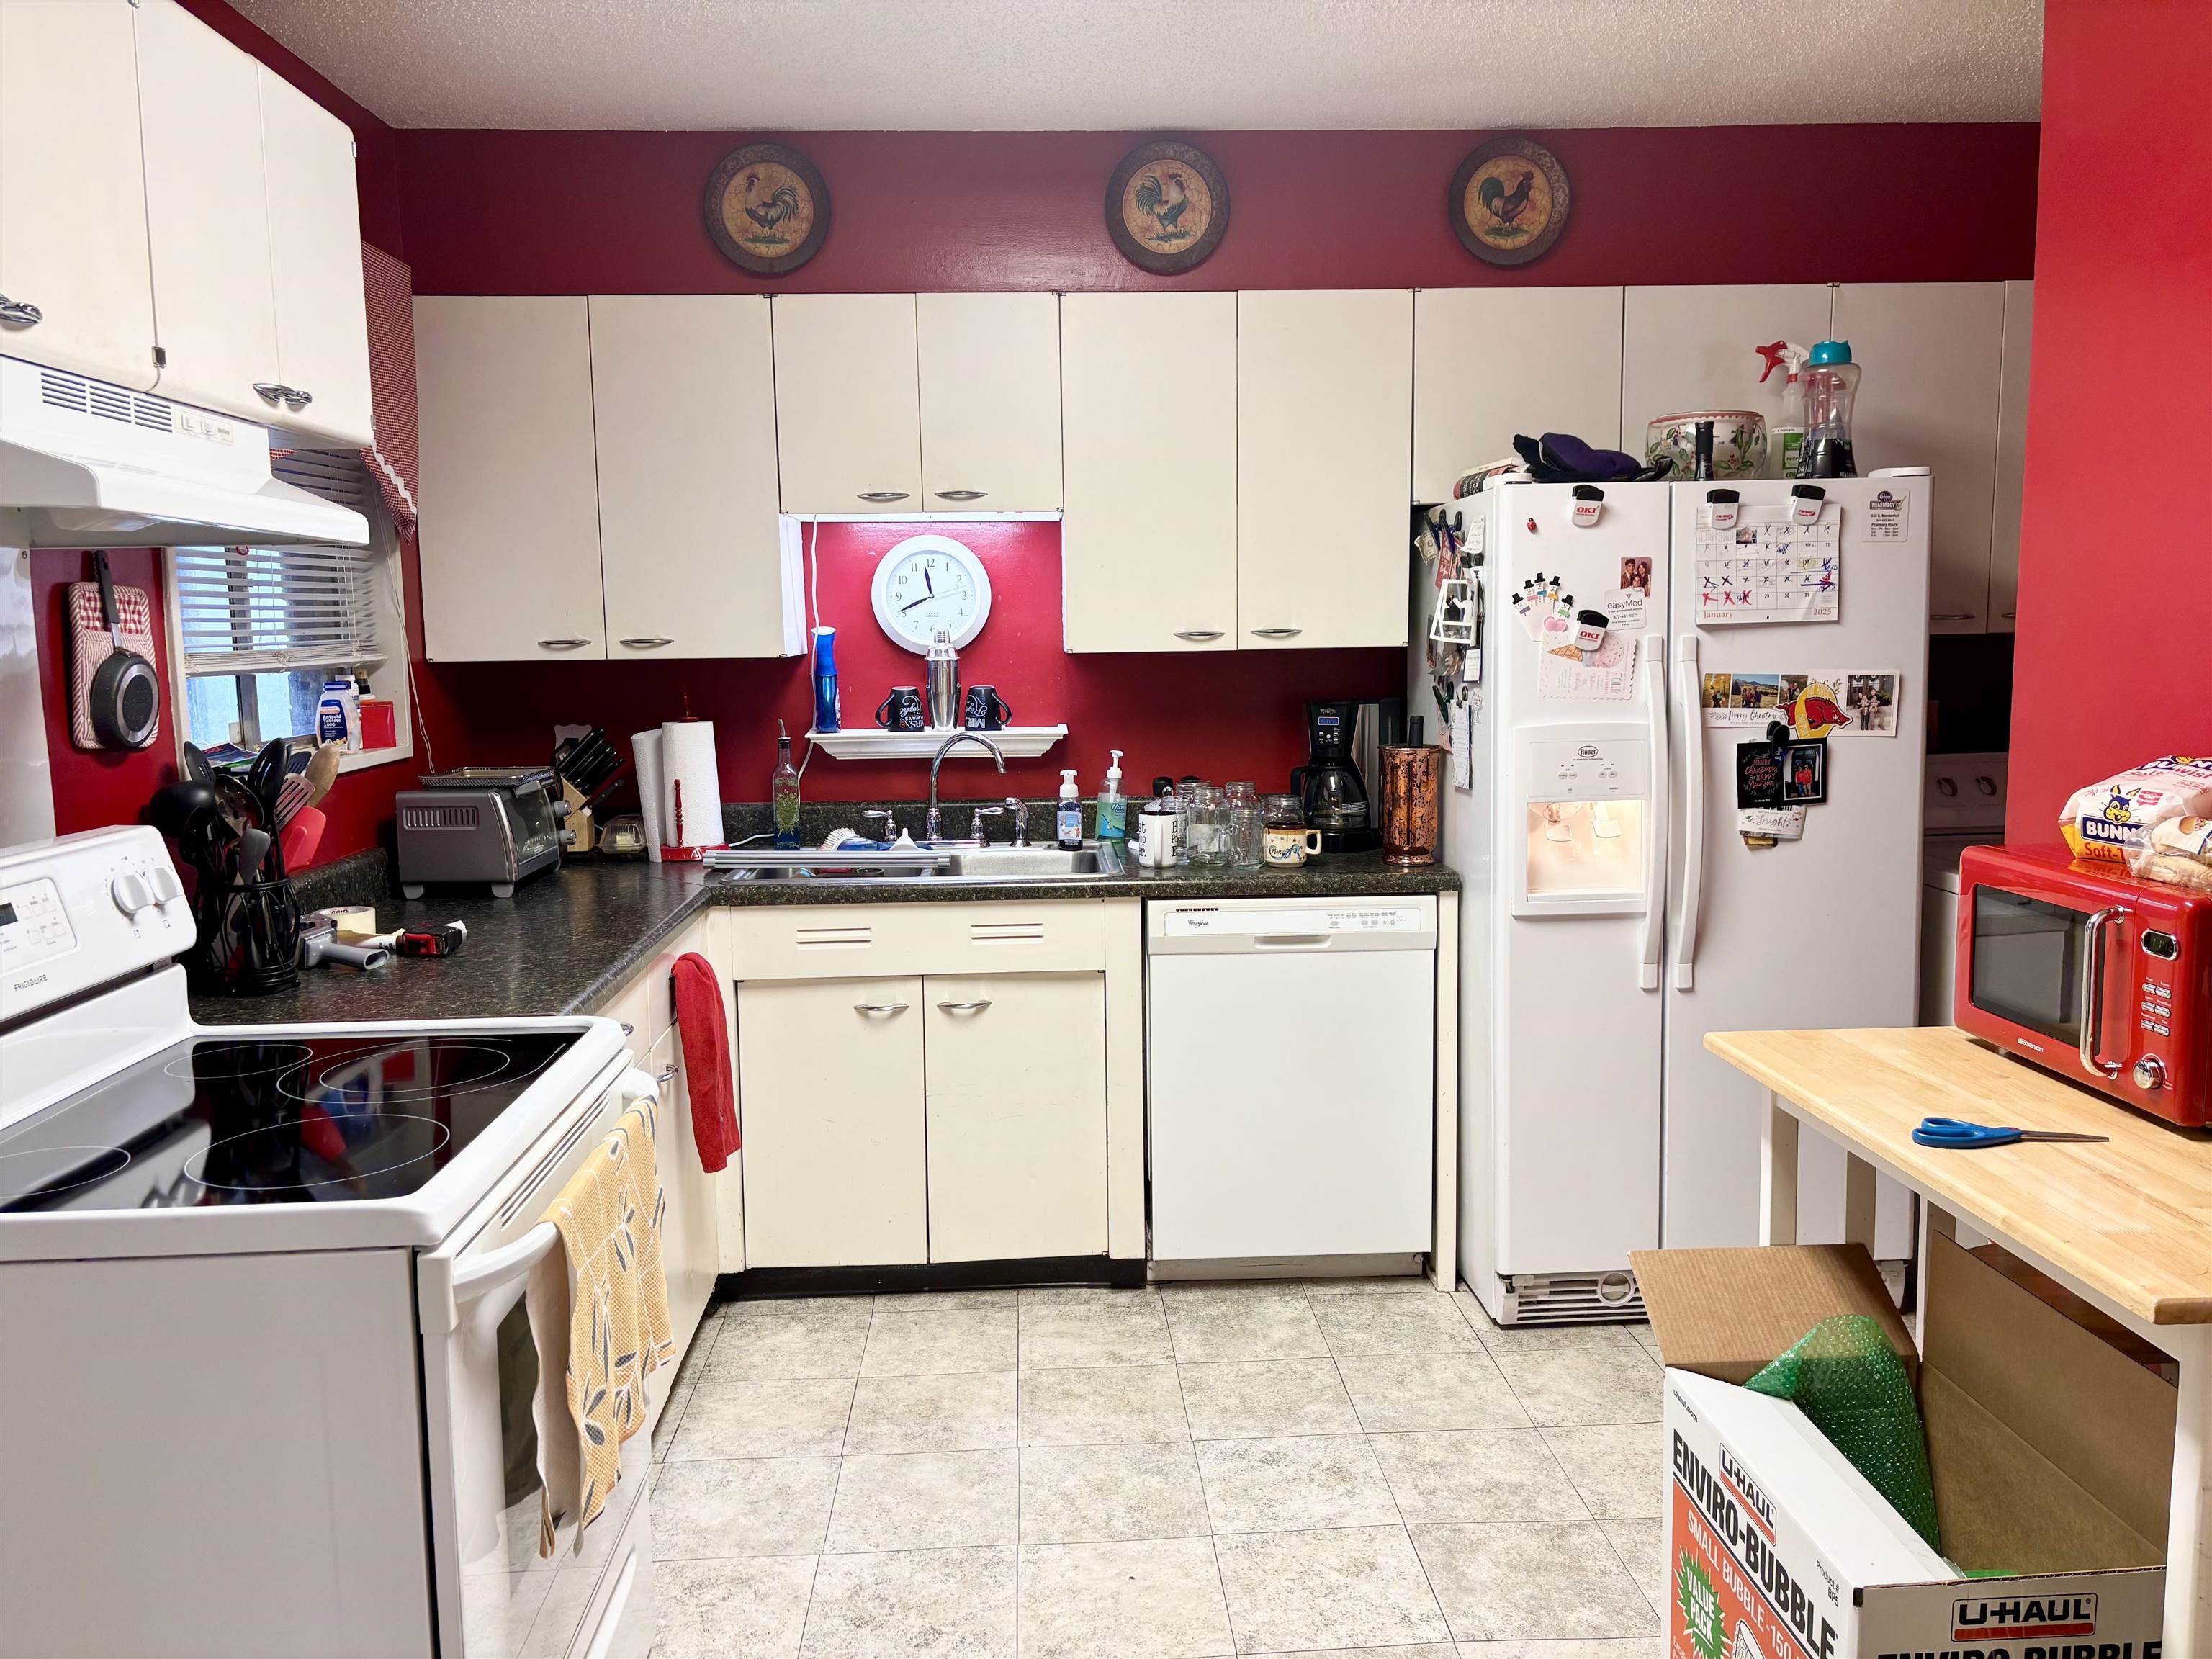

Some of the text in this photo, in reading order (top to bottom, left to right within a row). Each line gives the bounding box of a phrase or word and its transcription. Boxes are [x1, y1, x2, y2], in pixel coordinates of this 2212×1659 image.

[911, 562, 917, 572] 11
[927, 558, 935, 567] 12
[945, 562, 949, 572] 1
[899, 575, 907, 585] 10
[957, 575, 962, 584] 2
[962, 592, 967, 601] 3
[1607, 599, 1642, 609] easyMed
[901, 608, 907, 617] 8
[958, 608, 963, 617] 4
[1704, 611, 1734, 620] January
[913, 621, 919, 629] 7
[946, 620, 952, 629] 5
[1580, 631, 1601, 640] OKI
[1728, 709, 1748, 721] Merry
[966, 717, 985, 728] MR.
[1757, 814, 1786, 827] bright
[2086, 821, 2140, 841] BUNN
[2084, 843, 2125, 860] Soft-T
[14, 974, 48, 992] FRIGIDAIRE
[1673, 1389, 1698, 1423] uhaul.com
[1722, 1449, 1774, 1529] U-HAUL
[1673, 1429, 1835, 1659] ENVIRO-BUBBLE
[1688, 1509, 1720, 1573] SMALL
[1722, 1557, 1765, 1633] BUBBLE
[1816, 1560, 1835, 1588] Product
[1686, 1566, 1715, 1620] VALUE
[1827, 1586, 1839, 1608] BP5
[1959, 1598, 2092, 1625] U-HAUL
[1690, 1596, 1714, 1645] PACK
